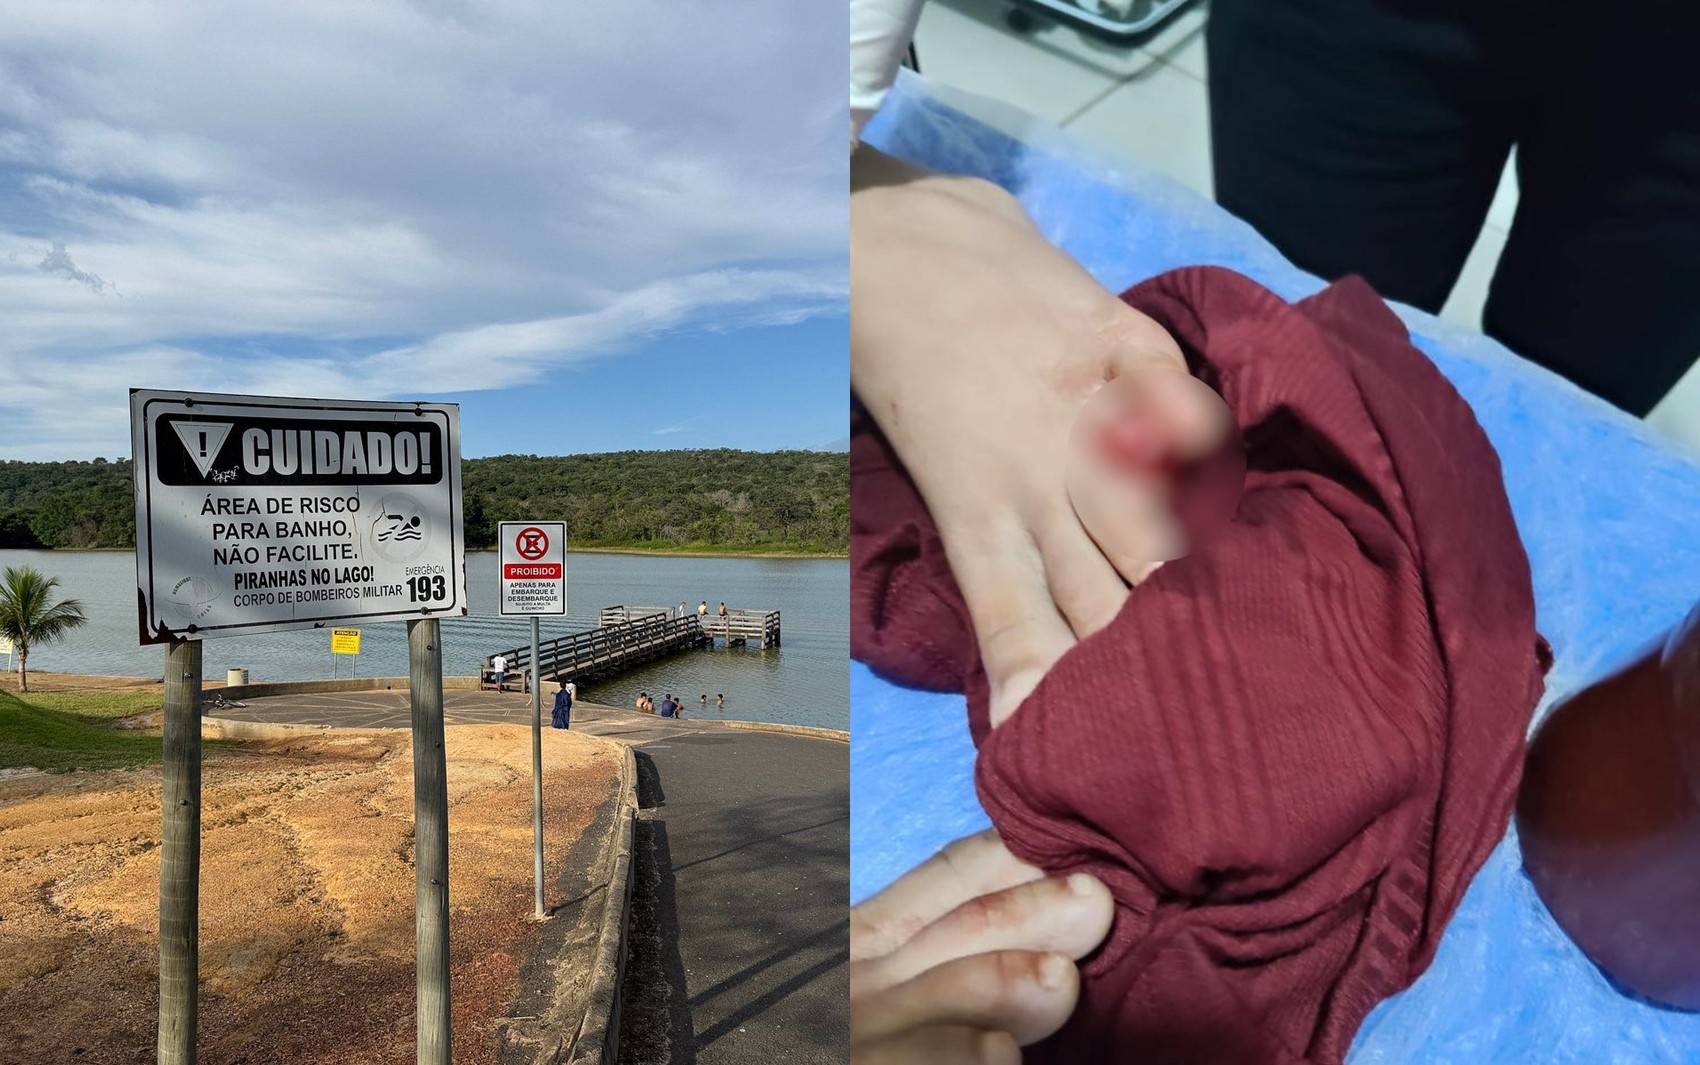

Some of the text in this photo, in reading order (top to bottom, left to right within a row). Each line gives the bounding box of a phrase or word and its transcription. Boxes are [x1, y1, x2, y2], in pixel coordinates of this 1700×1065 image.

[241, 427, 432, 476] CUIDADO!
[200, 493, 361, 516] ÁREA DE RISCO
[212, 520, 353, 541] PARA BANHO,
[213, 543, 359, 565] NÃO FACILITE.
[234, 565, 375, 590] PIRANHAS NO LAGO!
[405, 564, 446, 576] EMERGÊNCIA
[510, 567, 556, 576] PROIBIDO
[233, 584, 403, 607] CORPO DE BOMBEIROS MILITAR
[405, 575, 447, 603] 193
